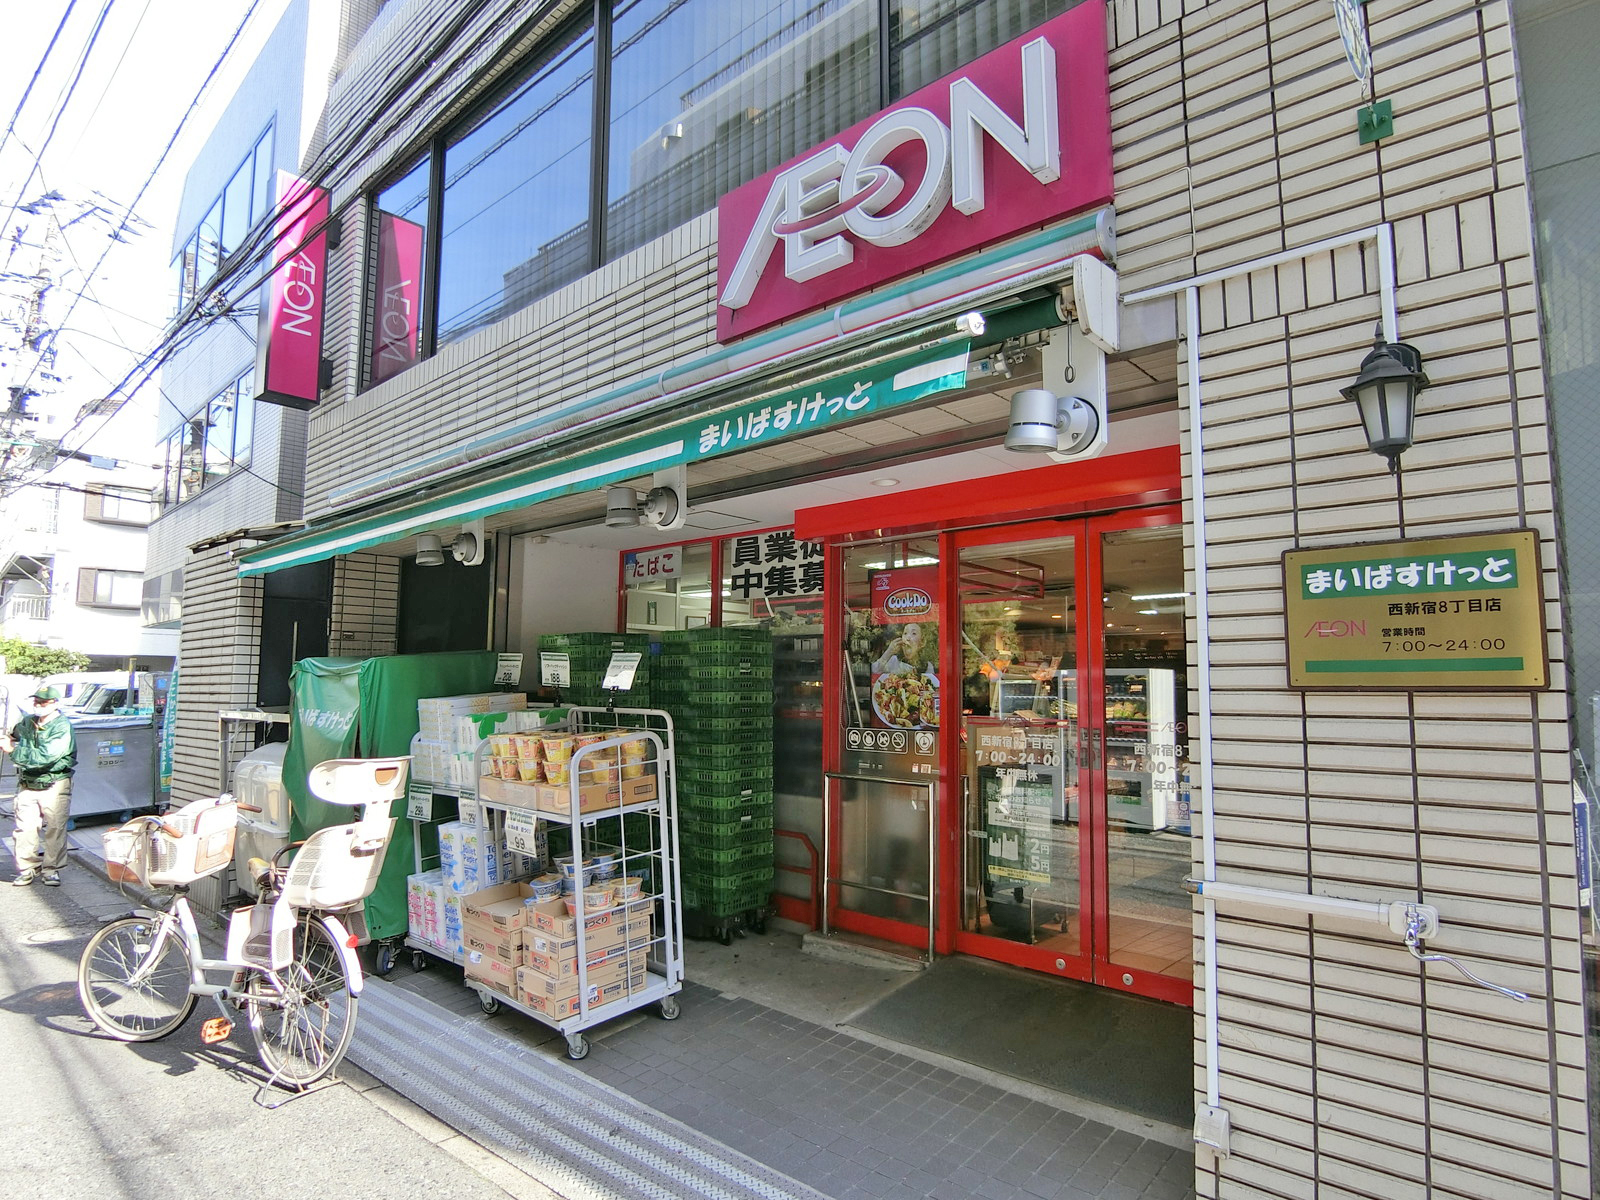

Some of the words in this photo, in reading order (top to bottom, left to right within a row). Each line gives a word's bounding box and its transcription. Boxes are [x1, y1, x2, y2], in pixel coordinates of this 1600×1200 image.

[699, 380, 873, 454] まいばすけっと
[632, 553, 674, 578] たばこ
[1305, 556, 1513, 594] まいばすけっと
[1387, 597, 1502, 616] 西新宿8丁目店
[1381, 627, 1426, 637] 営業時間
[514, 836, 525, 850] 99
